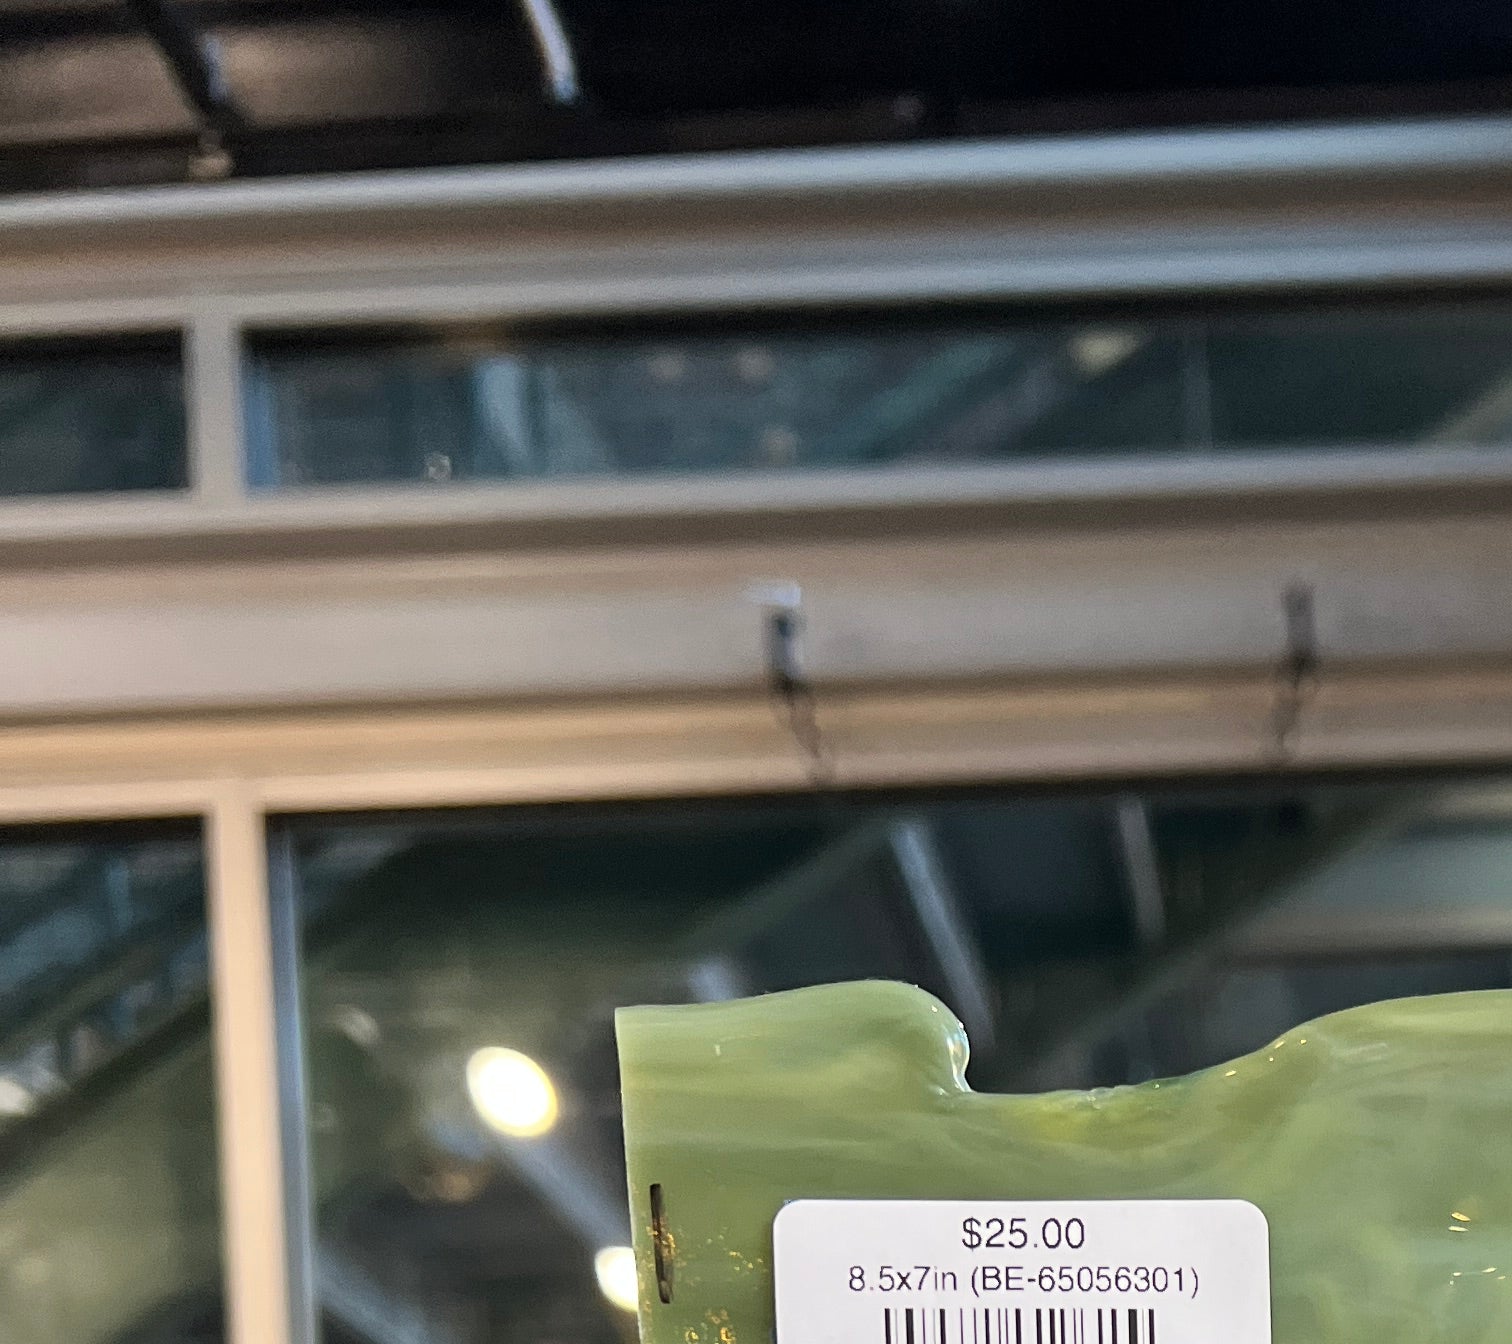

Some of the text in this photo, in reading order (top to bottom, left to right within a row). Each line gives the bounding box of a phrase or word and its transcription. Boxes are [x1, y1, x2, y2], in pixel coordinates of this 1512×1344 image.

[961, 1216, 1085, 1252] $25.00
[848, 1265, 1199, 1299] 8.5x7in (BE-65056301)
